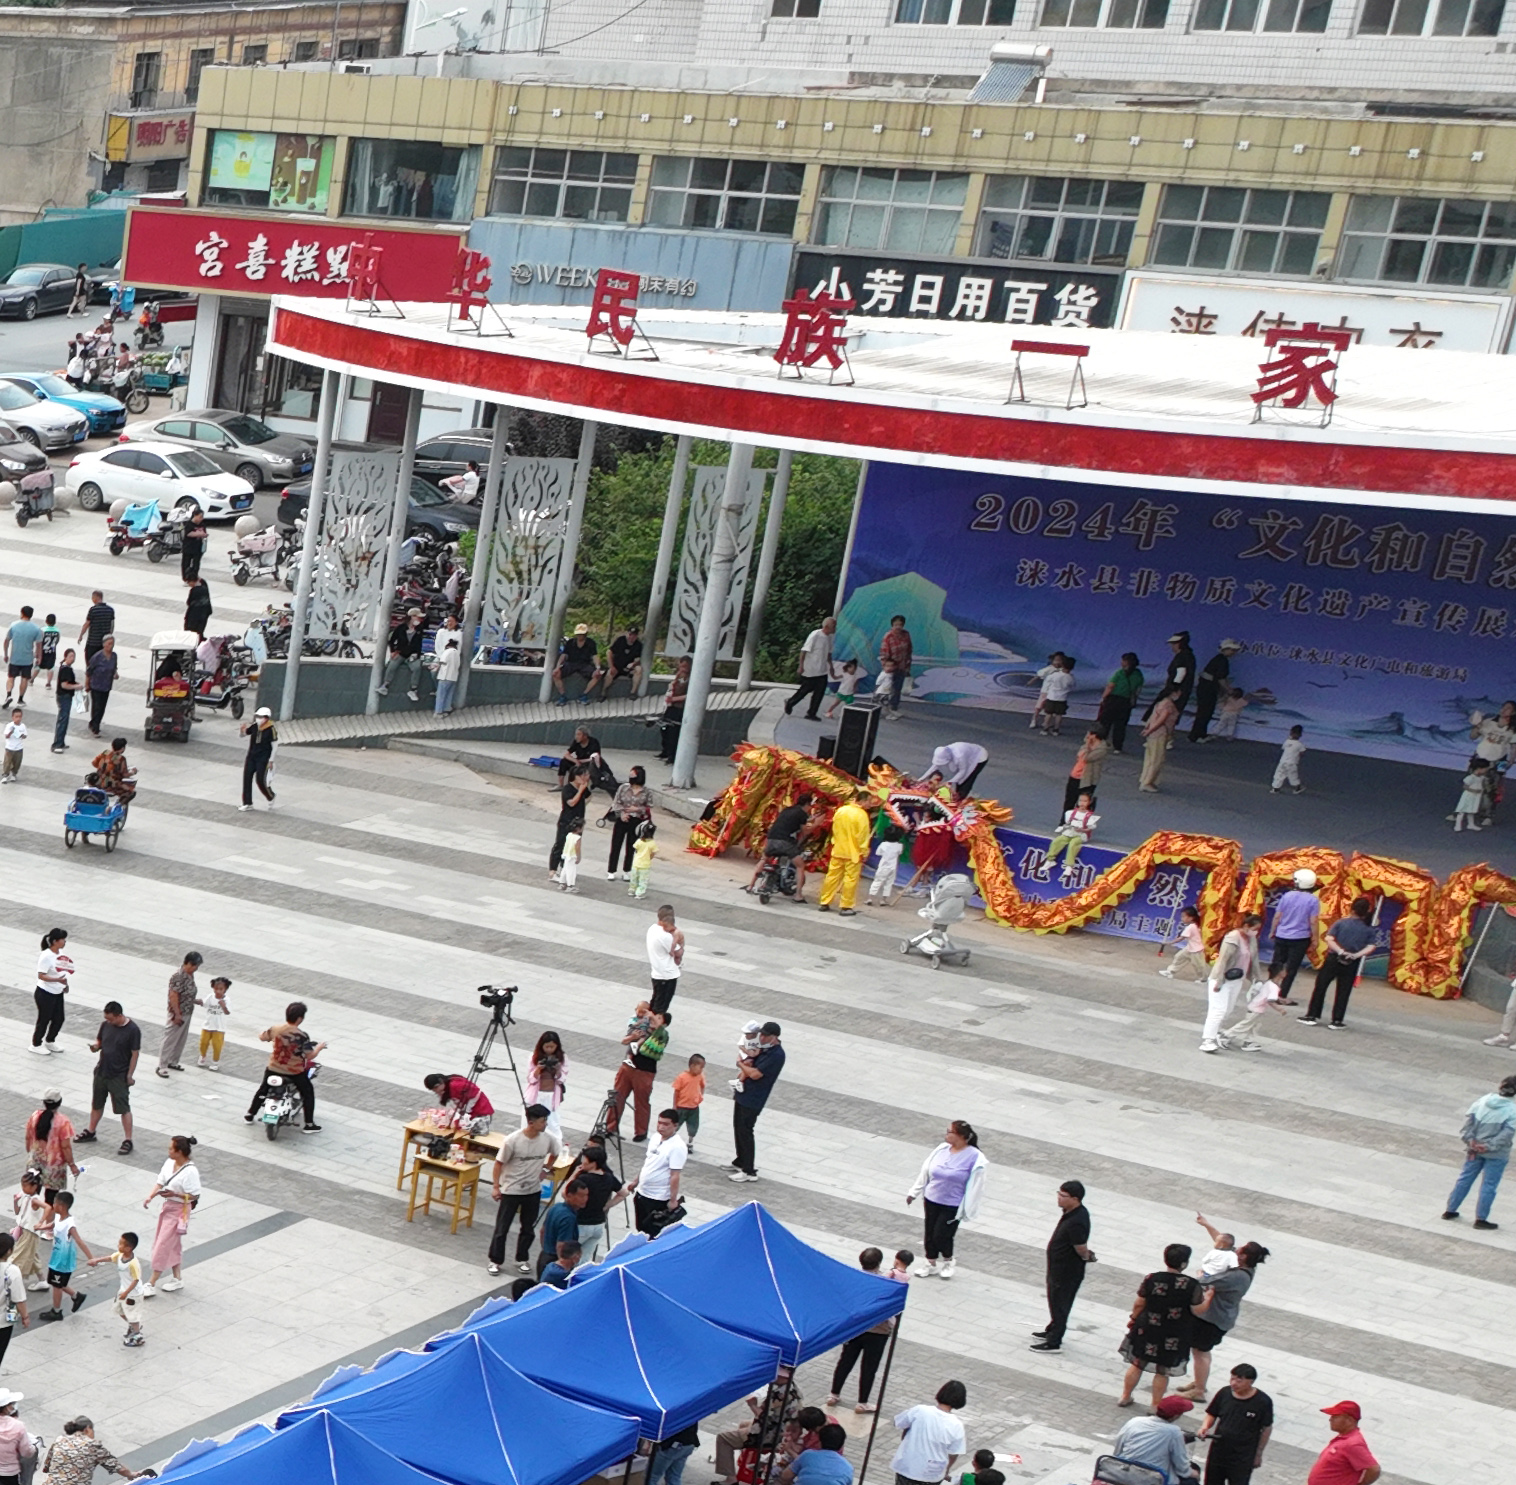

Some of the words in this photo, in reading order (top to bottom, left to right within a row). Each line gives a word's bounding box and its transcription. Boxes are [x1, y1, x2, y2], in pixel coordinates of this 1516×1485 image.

[808, 265, 1100, 329] 小芳日用百货
[971, 492, 1177, 553] 2024年
[1014, 557, 1516, 640] 涞水县非物质文化遗产宣传展
